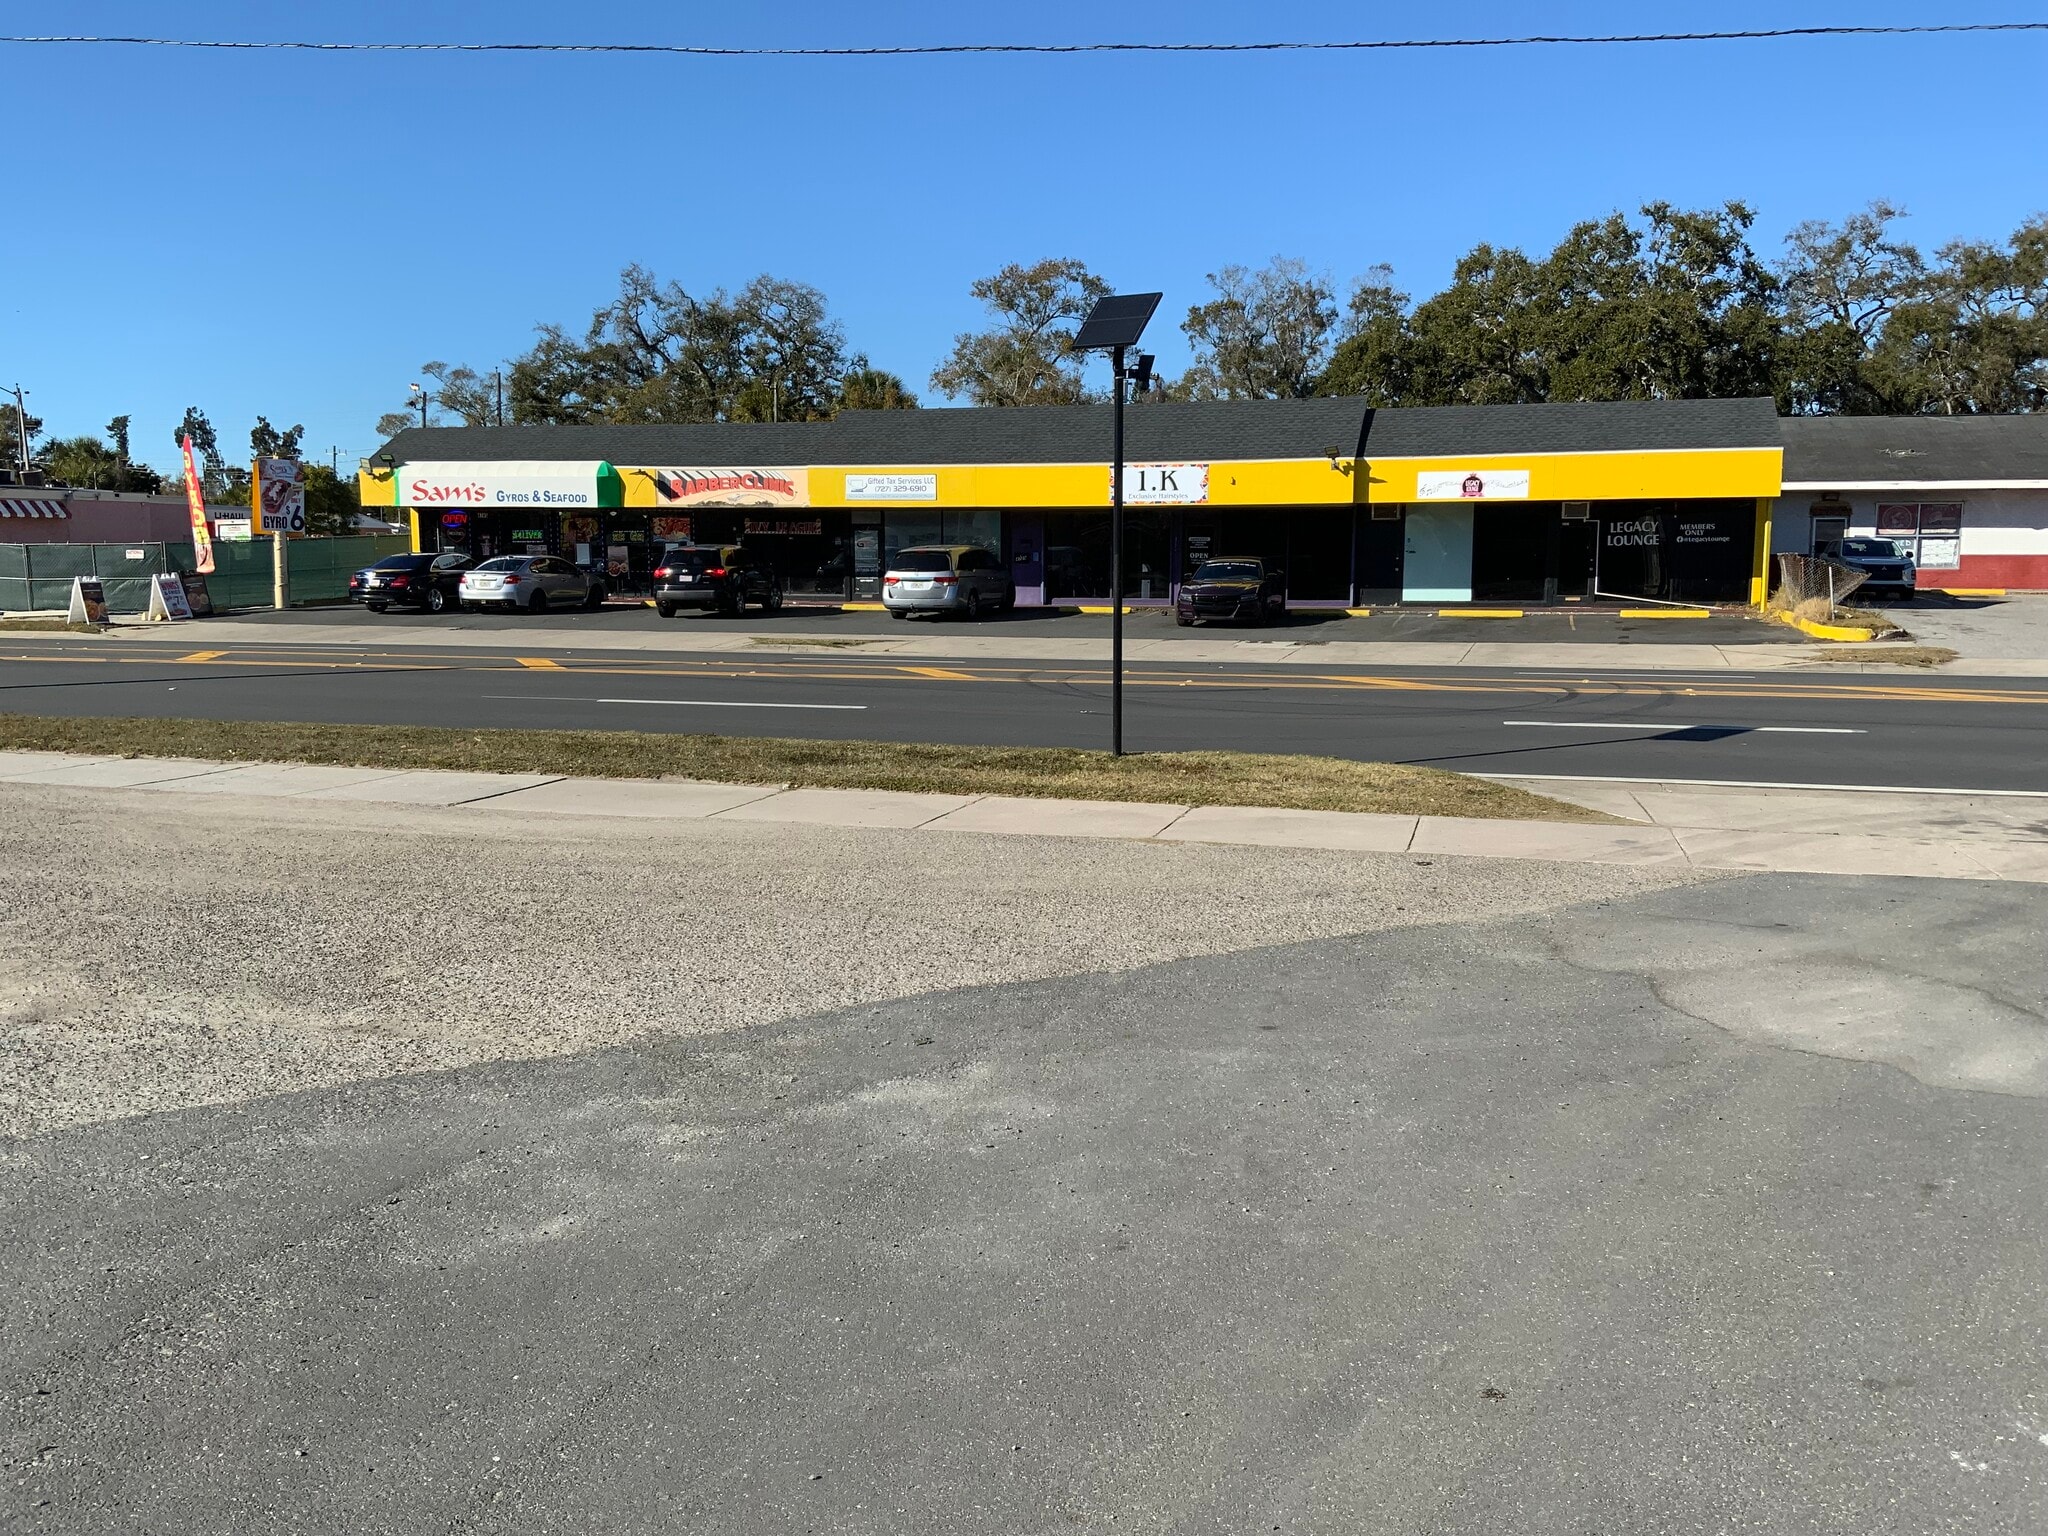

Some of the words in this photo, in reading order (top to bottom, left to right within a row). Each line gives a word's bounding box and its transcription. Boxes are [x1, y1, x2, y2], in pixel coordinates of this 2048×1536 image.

[868, 477, 885, 485] Gifted
[886, 477, 896, 485] Tax
[898, 477, 922, 485] Services
[924, 477, 935, 485] LLC
[412, 479, 486, 502] Sam's
[532, 489, 541, 502] &
[874, 485, 892, 493] (727)
[263, 515, 288, 529] GYRO
[442, 514, 468, 524] OPEN
[1610, 521, 1659, 533] LEGACY
[1607, 534, 1660, 546] LOUNGE
